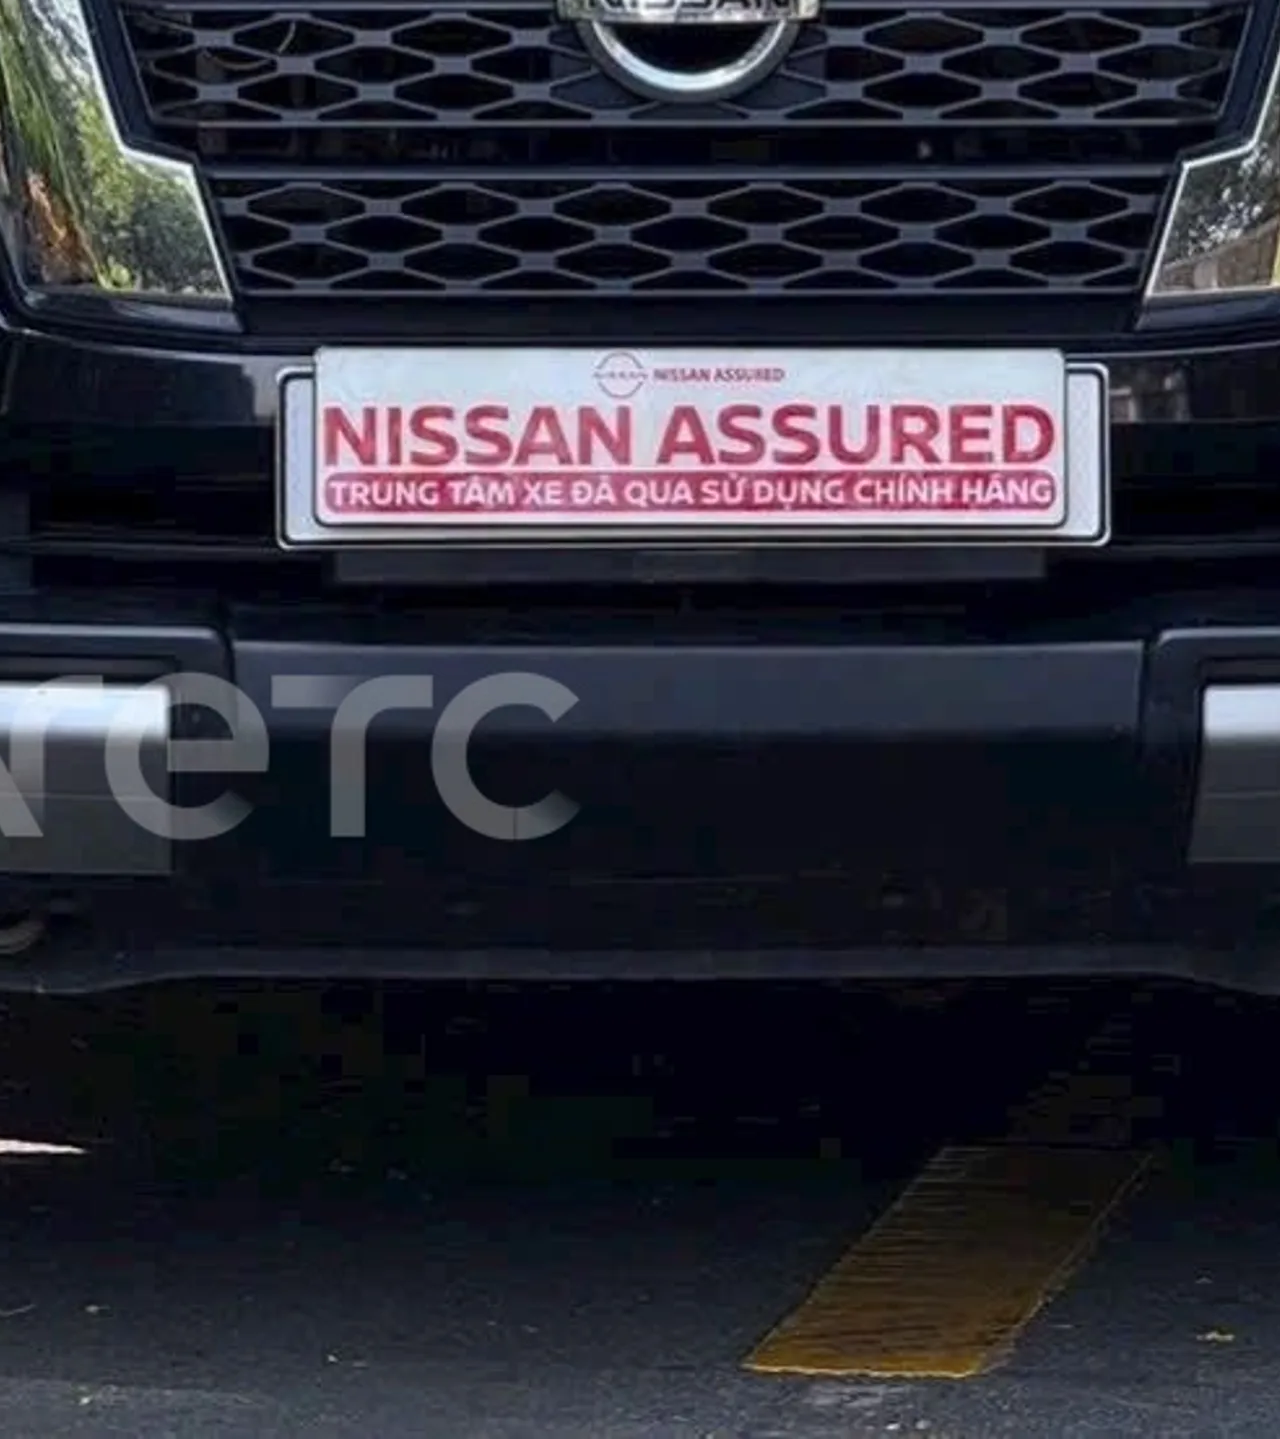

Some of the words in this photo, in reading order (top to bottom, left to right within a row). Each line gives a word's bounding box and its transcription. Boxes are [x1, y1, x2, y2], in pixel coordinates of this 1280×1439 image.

[653, 368, 710, 382] NISSAN
[713, 368, 785, 382] ASSURED
[323, 405, 632, 466] NISSAN
[656, 404, 1055, 466] ASSURED
[330, 479, 439, 505] TRUNG
[447, 475, 515, 505] TÂM
[522, 480, 563, 505] XE
[624, 480, 695, 507] QUA
[753, 479, 845, 510] DỤNG
[852, 473, 953, 504] CHÍNH
